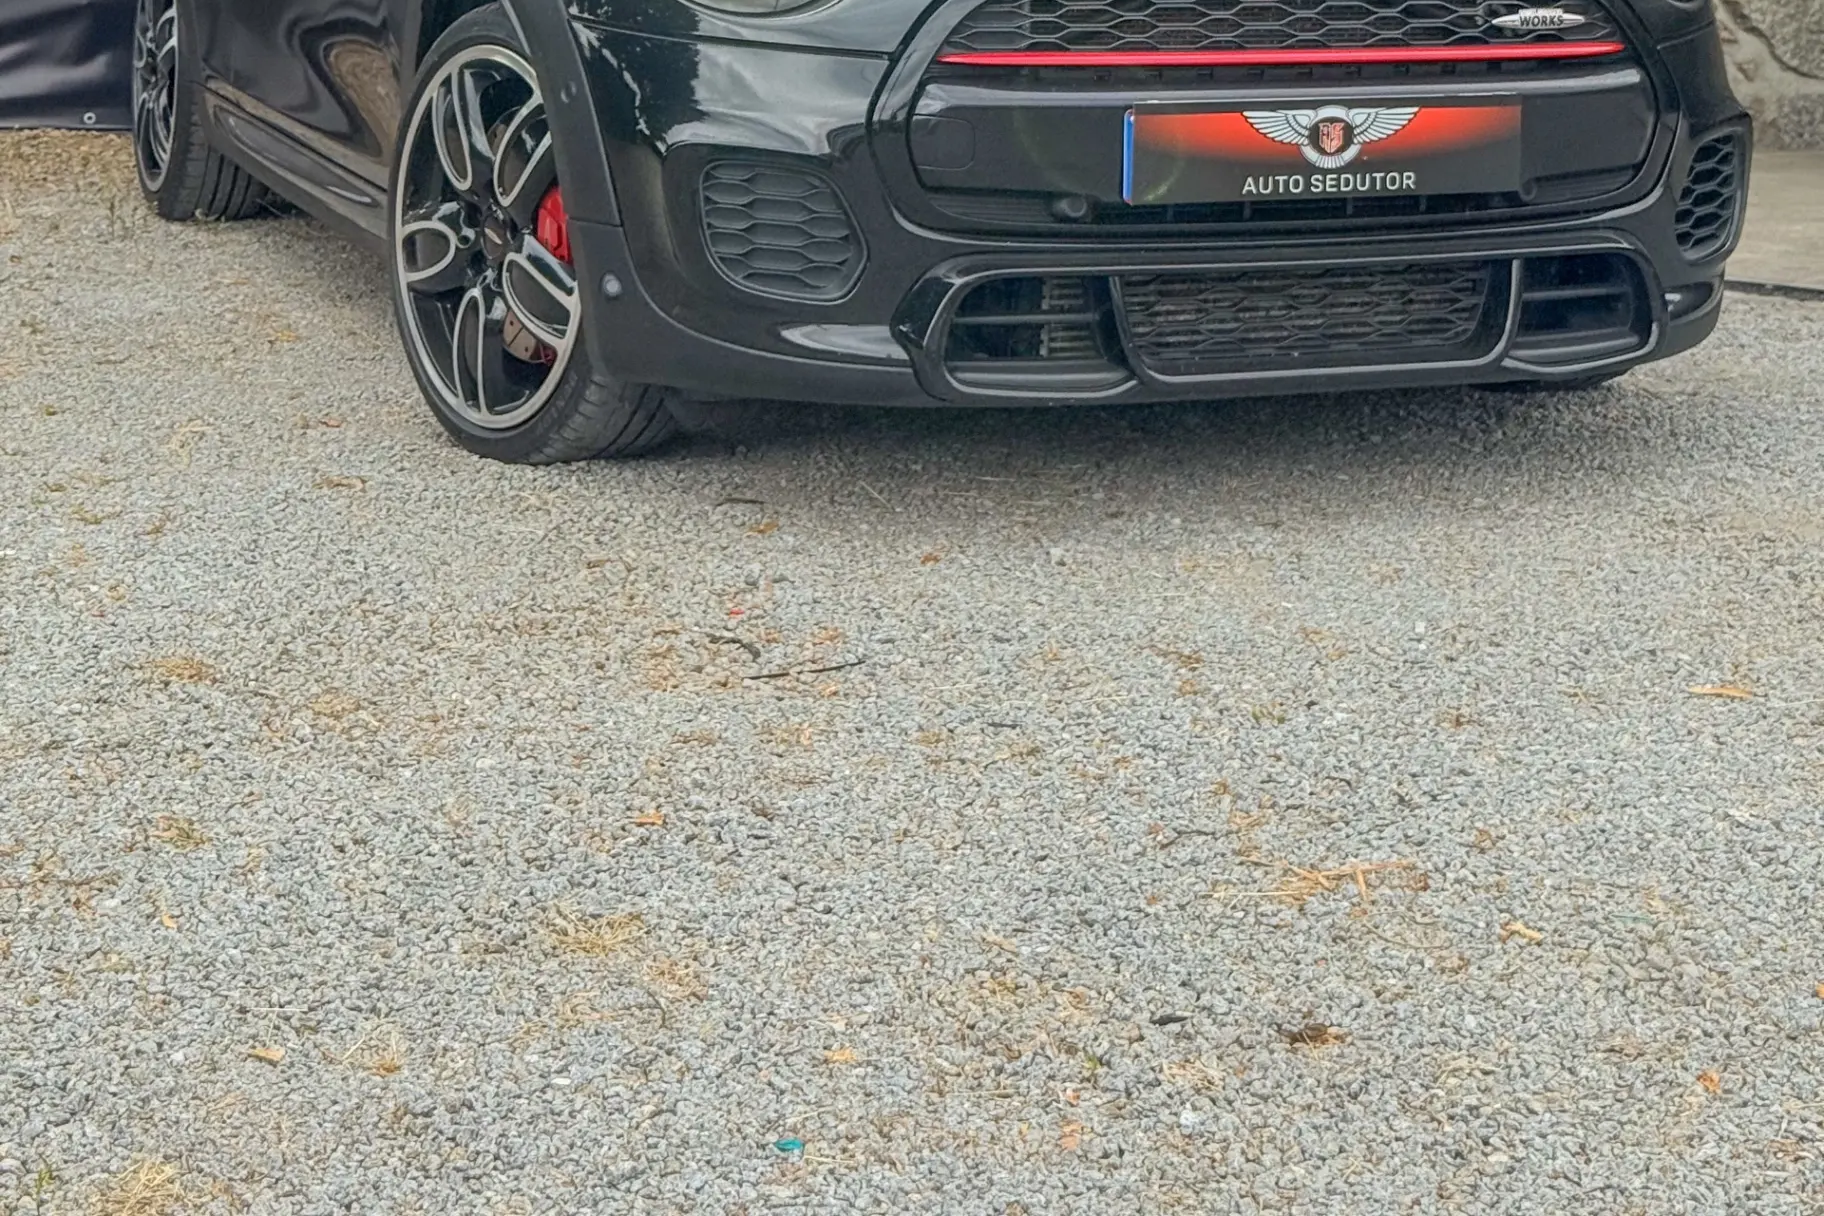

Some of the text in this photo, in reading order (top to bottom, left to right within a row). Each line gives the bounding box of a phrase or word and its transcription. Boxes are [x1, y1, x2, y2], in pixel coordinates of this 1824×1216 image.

[1519, 14, 1564, 28] WORKS
[1241, 170, 1417, 196] AUTO SEDUTOR
